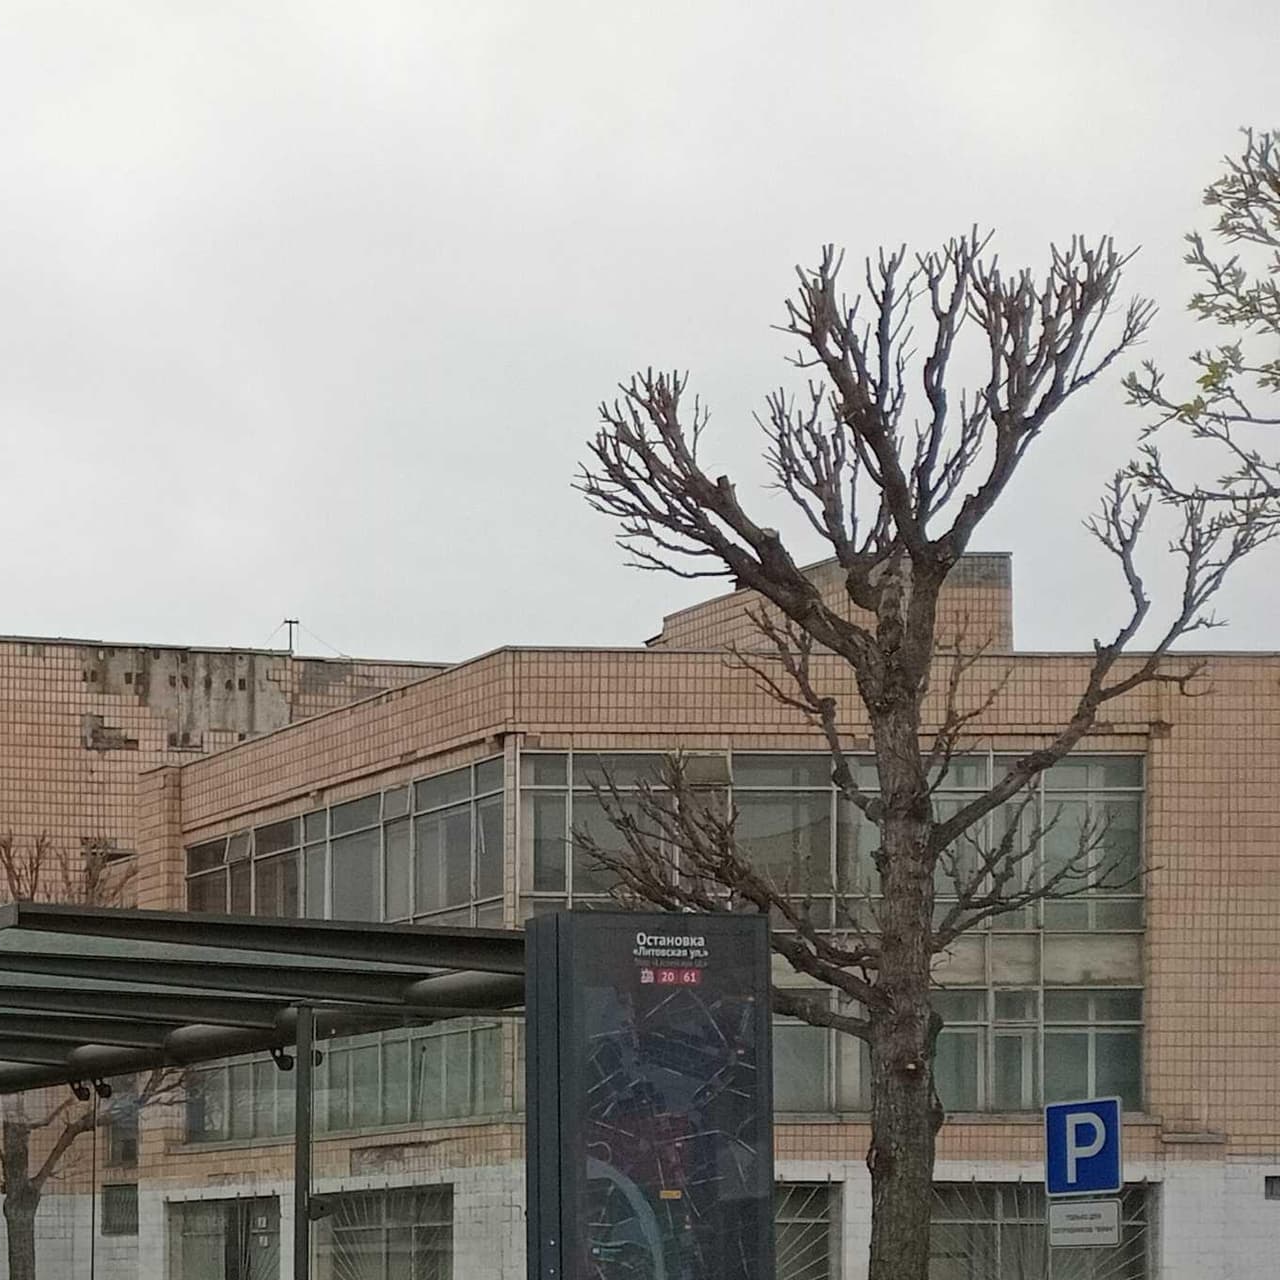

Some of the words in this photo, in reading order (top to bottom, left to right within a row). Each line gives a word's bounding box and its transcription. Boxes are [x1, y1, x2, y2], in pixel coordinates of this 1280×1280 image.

[636, 932, 705, 946] Остановка
[661, 971, 675, 982] 20
[683, 971, 697, 983] 61
[1065, 1112, 1107, 1184] P
